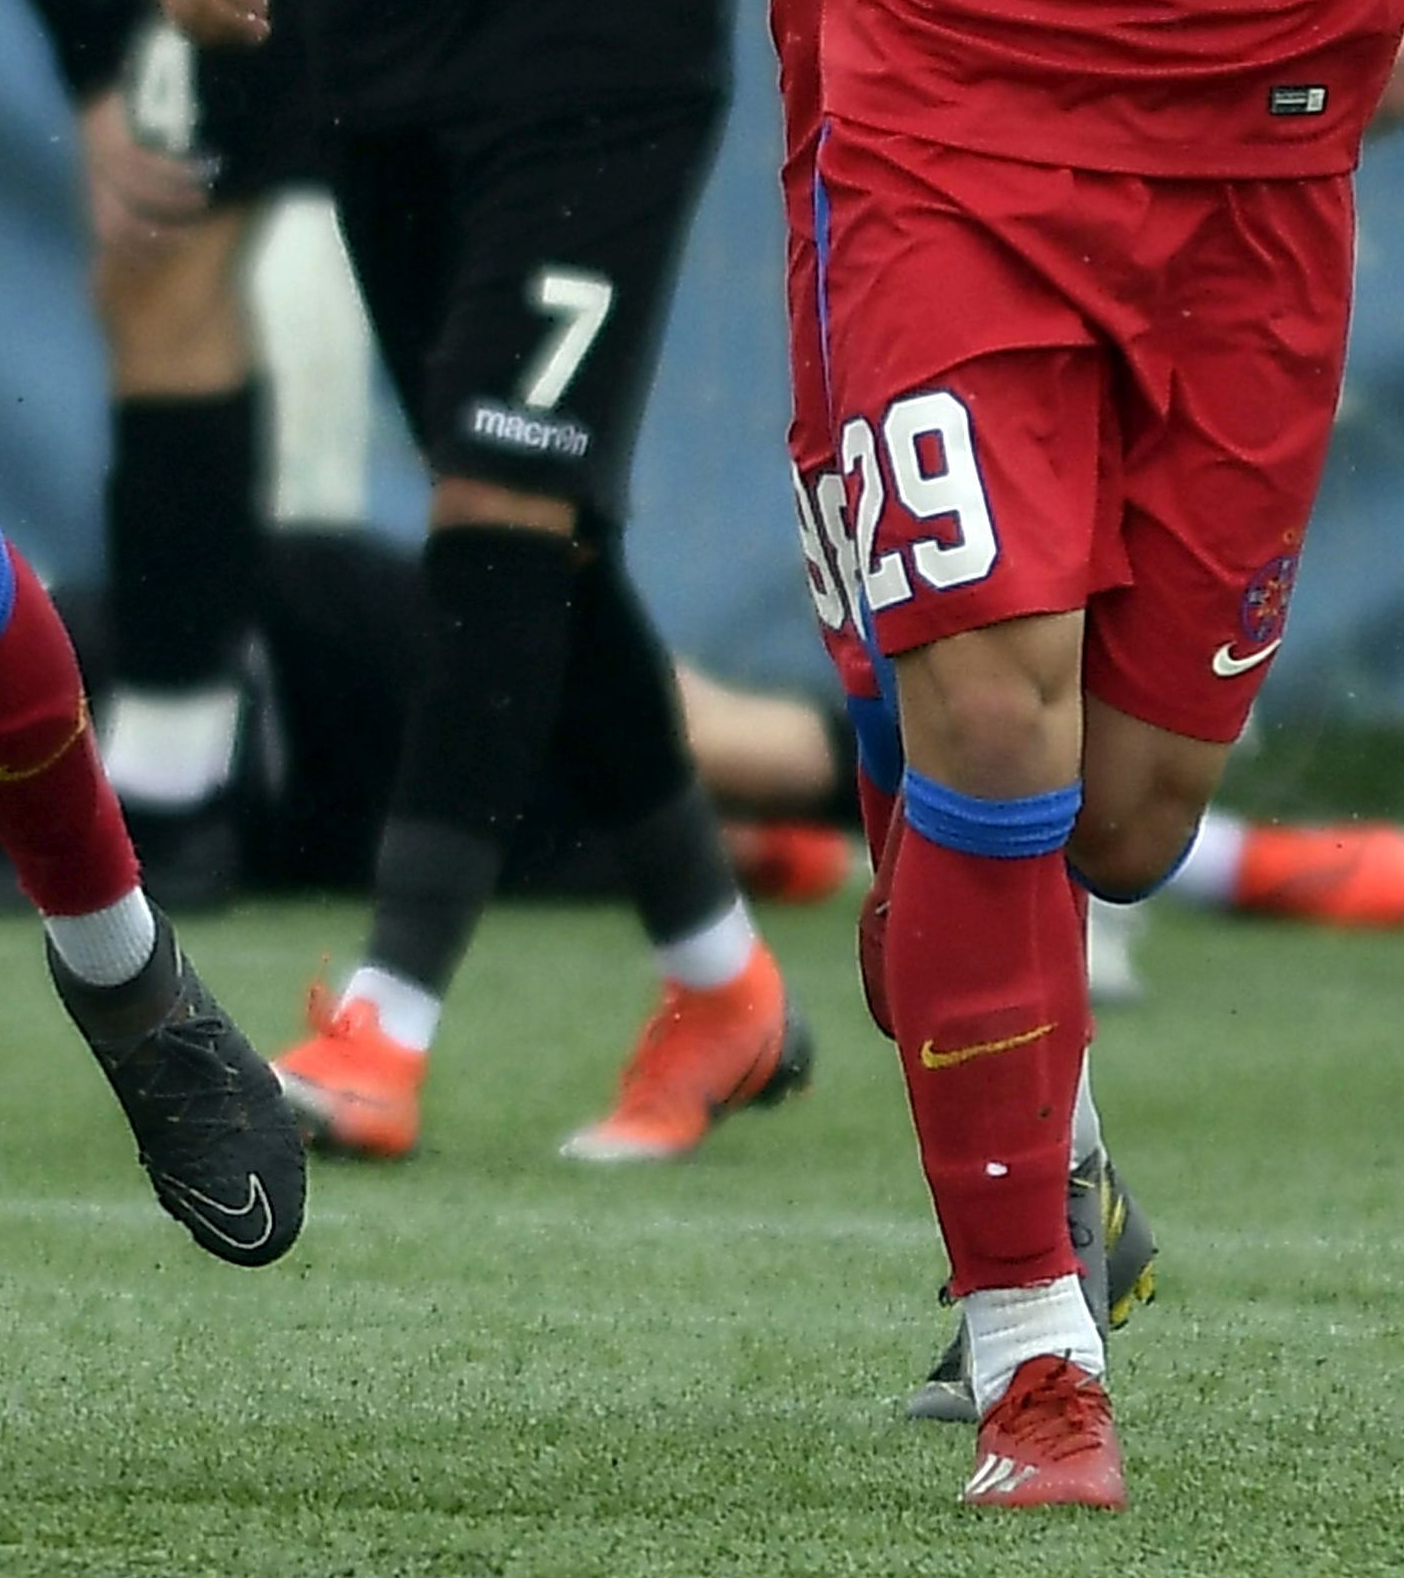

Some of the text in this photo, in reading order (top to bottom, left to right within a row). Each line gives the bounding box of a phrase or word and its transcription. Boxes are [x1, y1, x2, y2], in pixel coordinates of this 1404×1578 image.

[525, 275, 613, 409] 7
[474, 407, 589, 456] macron
[841, 391, 998, 611] 29
